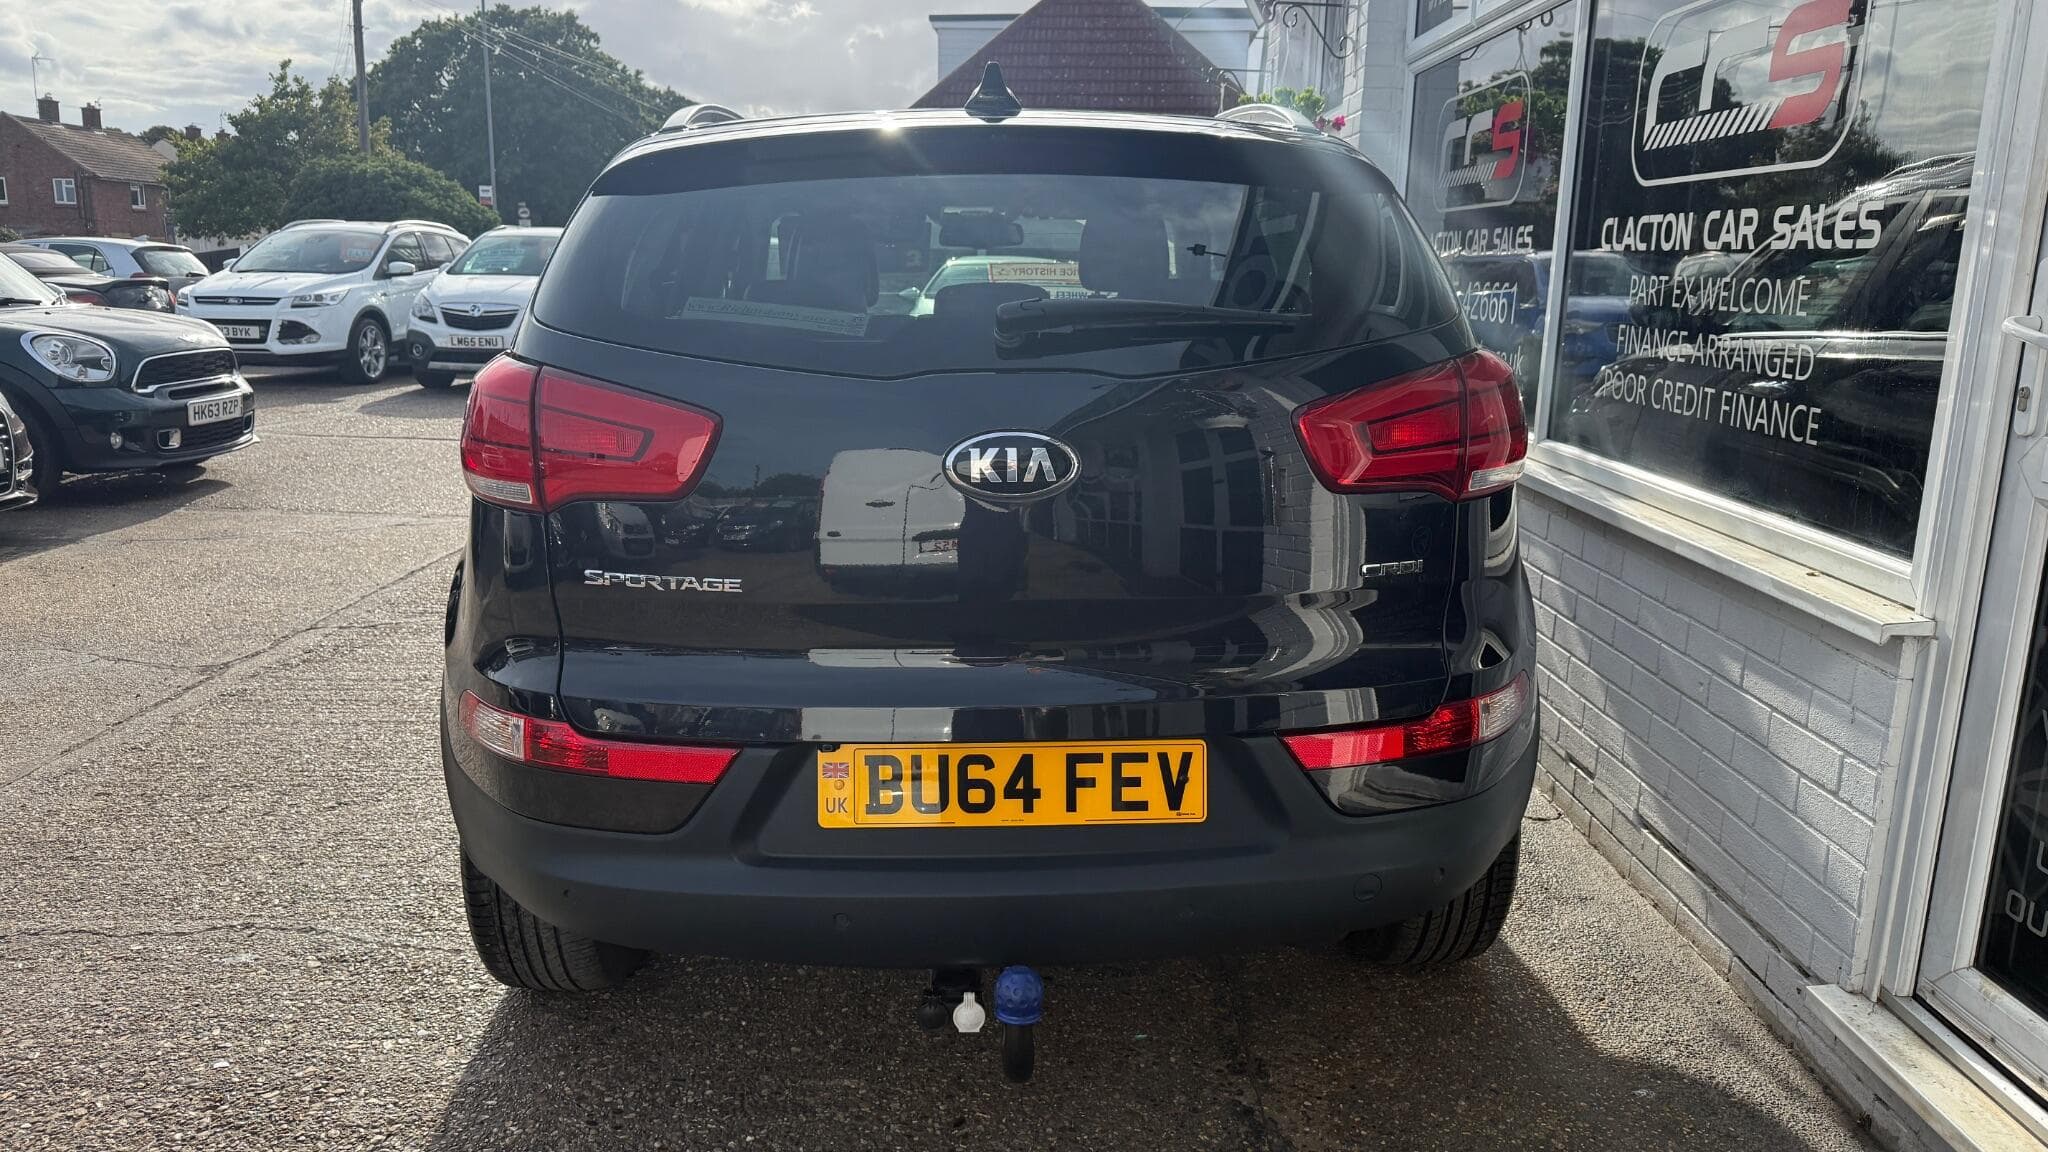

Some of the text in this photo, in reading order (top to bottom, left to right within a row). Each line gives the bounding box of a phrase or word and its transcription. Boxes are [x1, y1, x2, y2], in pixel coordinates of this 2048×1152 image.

[1465, 228, 1489, 255] CAR
[1493, 225, 1534, 254] SALES
[1601, 200, 1885, 251] CLACTON CAR SALES
[1629, 275, 1811, 317] PART EX WELCOME
[232, 327, 251, 337] BYK
[450, 336, 498, 348] LM65 ENU
[1616, 324, 1815, 381] FINANCE ARRANGED
[193, 398, 239, 421] HK63 RZP
[1602, 368, 1822, 446] POOR CREDIT FINANCE
[968, 447, 1057, 483] KIA
[864, 751, 1194, 816] BU64 FEV
[825, 797, 849, 814] UK
